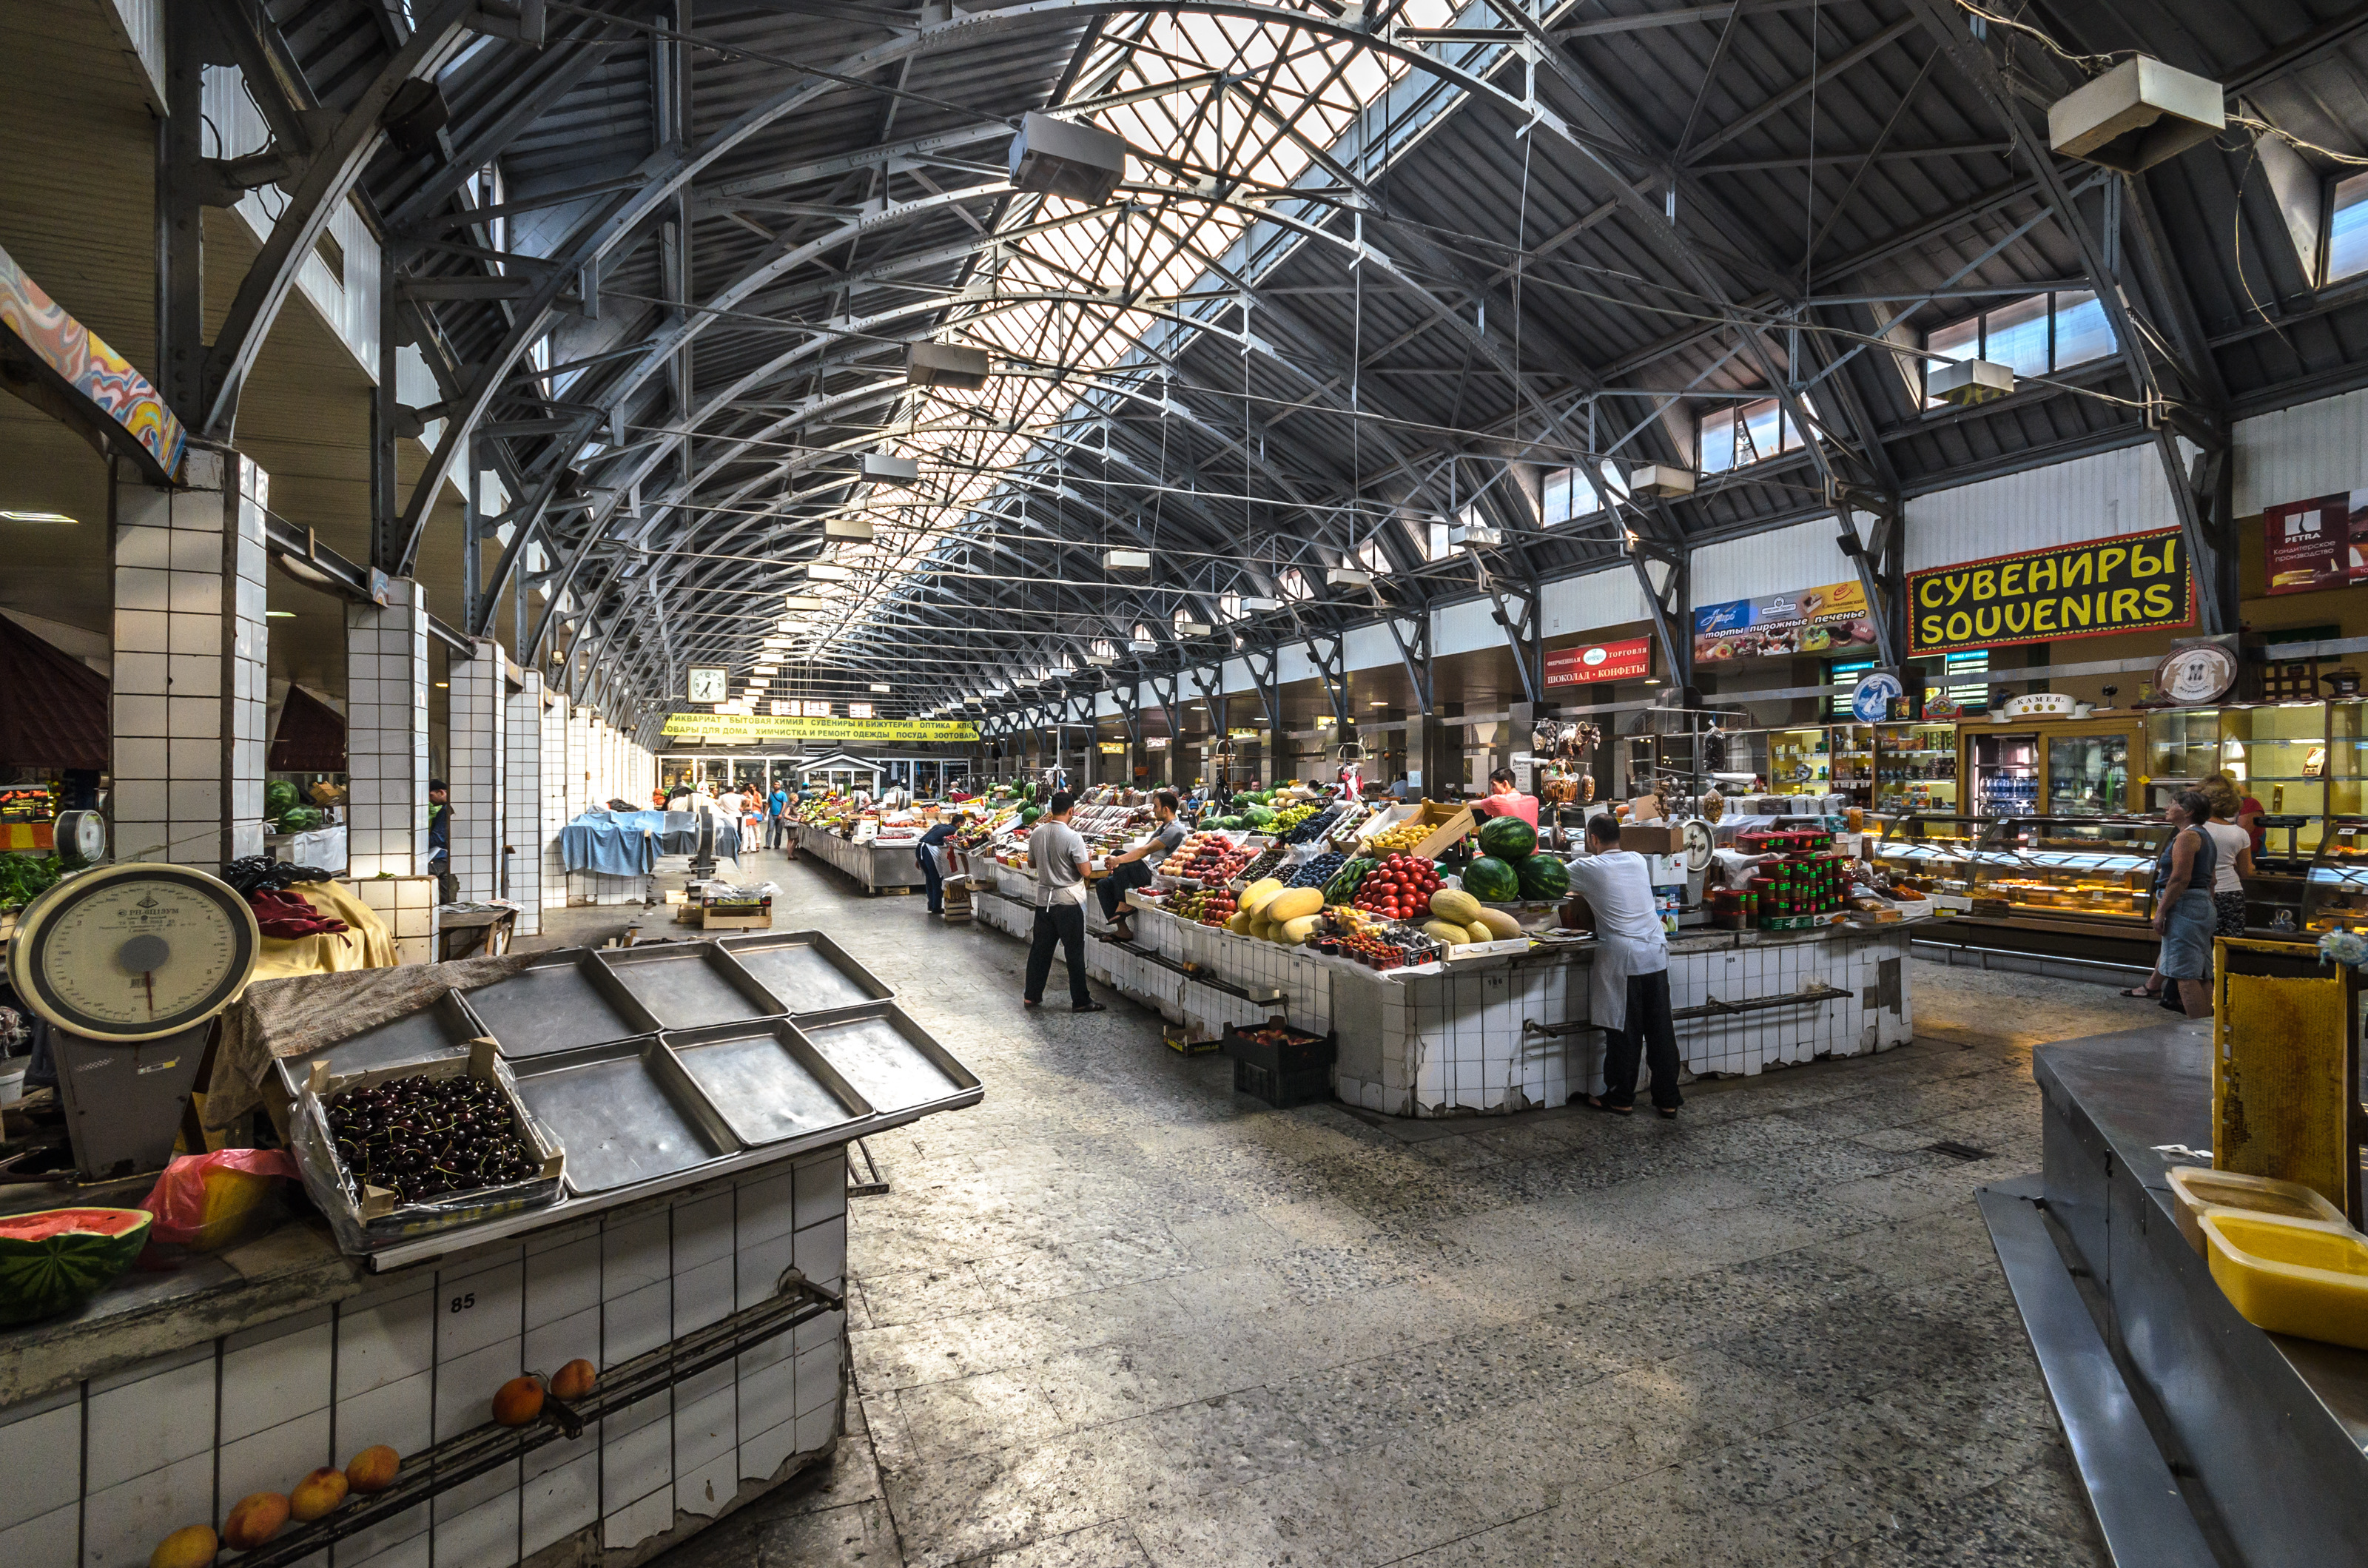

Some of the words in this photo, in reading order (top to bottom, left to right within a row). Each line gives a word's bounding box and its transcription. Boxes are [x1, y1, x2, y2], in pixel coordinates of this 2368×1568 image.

[2285, 533, 2321, 543] PETRA
[2273, 540, 2336, 556] Кондитерское
[2275, 548, 2335, 562] производство
[1920, 539, 2177, 608] СУВЕНИРЫ
[1921, 584, 2174, 645] SOUVENIRS
[1704, 627, 1744, 639] торты
[1749, 618, 1808, 633] пирожные
[1814, 610, 1865, 624] печенье
[1547, 656, 1581, 667] ФИРМЕННАЯ
[1609, 647, 1647, 659] ТОРГОВЛЯ
[1547, 670, 1590, 684] ШОКОЛАД
[1598, 664, 1646, 679] КОНФЕТЫ
[670, 714, 722, 724] ТИКВАРИАТ
[729, 716, 771, 725] БЫТОВАЯ
[774, 718, 804, 726] ХИМИЯ
[811, 719, 855, 727] СУВЕНИРЫ
[866, 720, 913, 729] БИЖУТЕРИЯ
[920, 721, 950, 730] ОПТИКА
[702, 727, 720, 735] ДЛЯ
[722, 727, 748, 736] ДОМА
[756, 728, 807, 736] ХИМЧИСТКА
[818, 730, 850, 738] РЕМОНТ
[853, 730, 889, 738] ОДЕЖДЫ
[896, 731, 927, 739] ПОСУДА
[934, 731, 977, 739] ЗООТОВАРЫ
[1487, 978, 1503, 986] 106
[451, 1292, 475, 1313] 85
